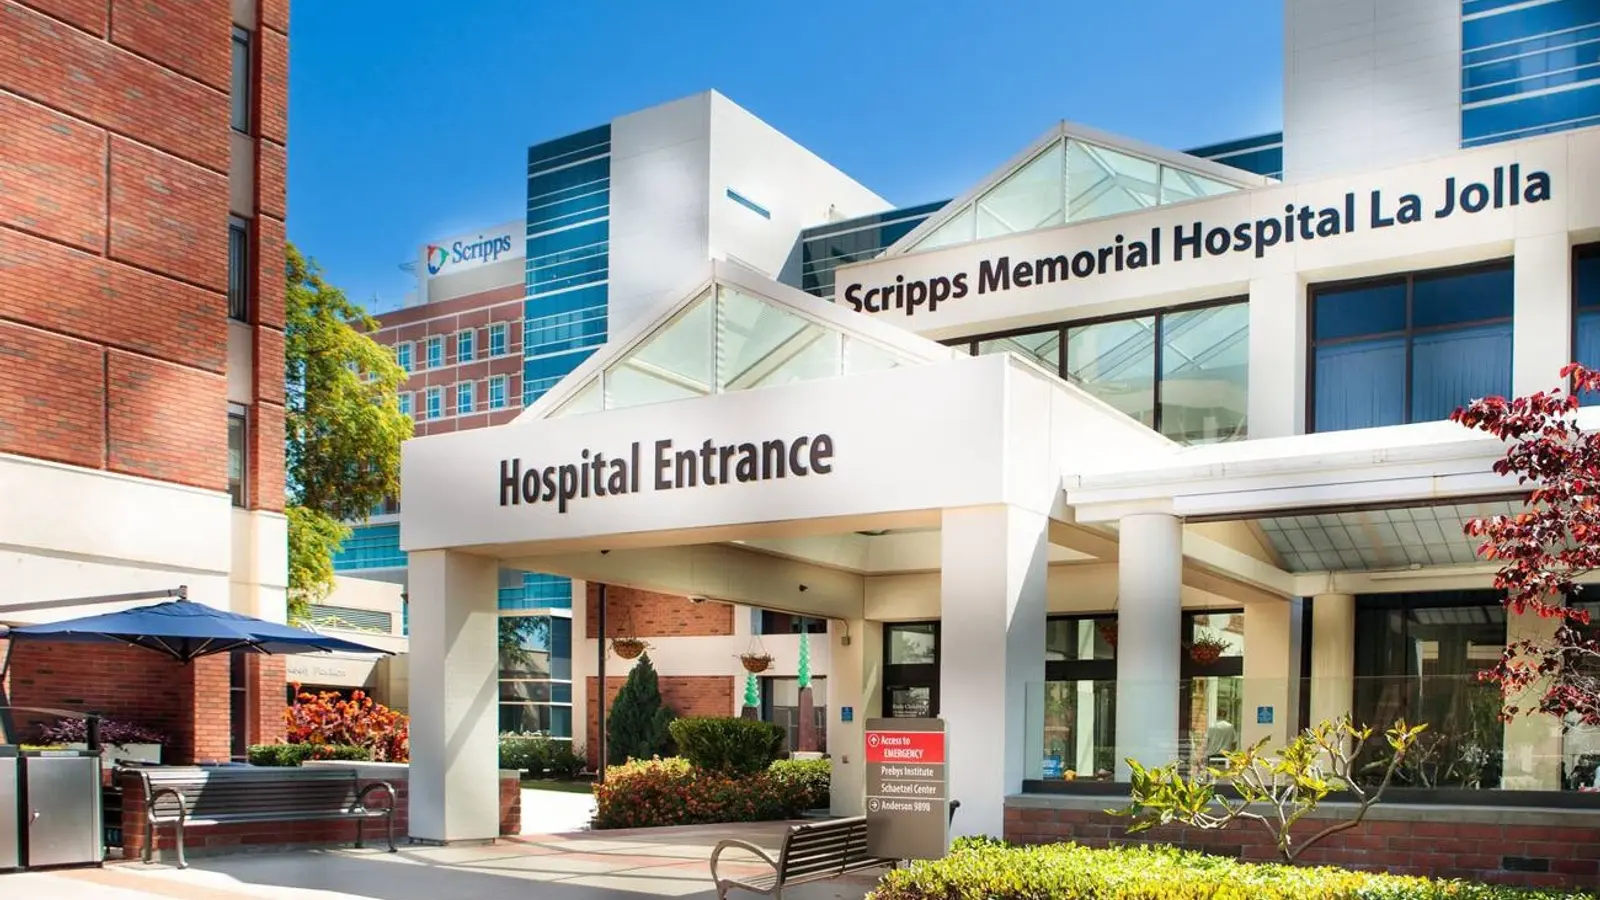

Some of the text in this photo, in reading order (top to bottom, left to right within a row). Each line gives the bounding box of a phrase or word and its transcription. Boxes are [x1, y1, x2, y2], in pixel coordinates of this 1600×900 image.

[845, 163, 1551, 316] Scripps Memorial Hospital La Jolla
[452, 234, 511, 263] Scripps
[499, 434, 833, 514] Hospital Entrance
[881, 735, 911, 746] Access to
[884, 748, 924, 759] EMERGENCY
[881, 766, 934, 778] Prebys Institute
[881, 783, 936, 795] Schaetzel Center
[881, 801, 912, 811] Anderson
